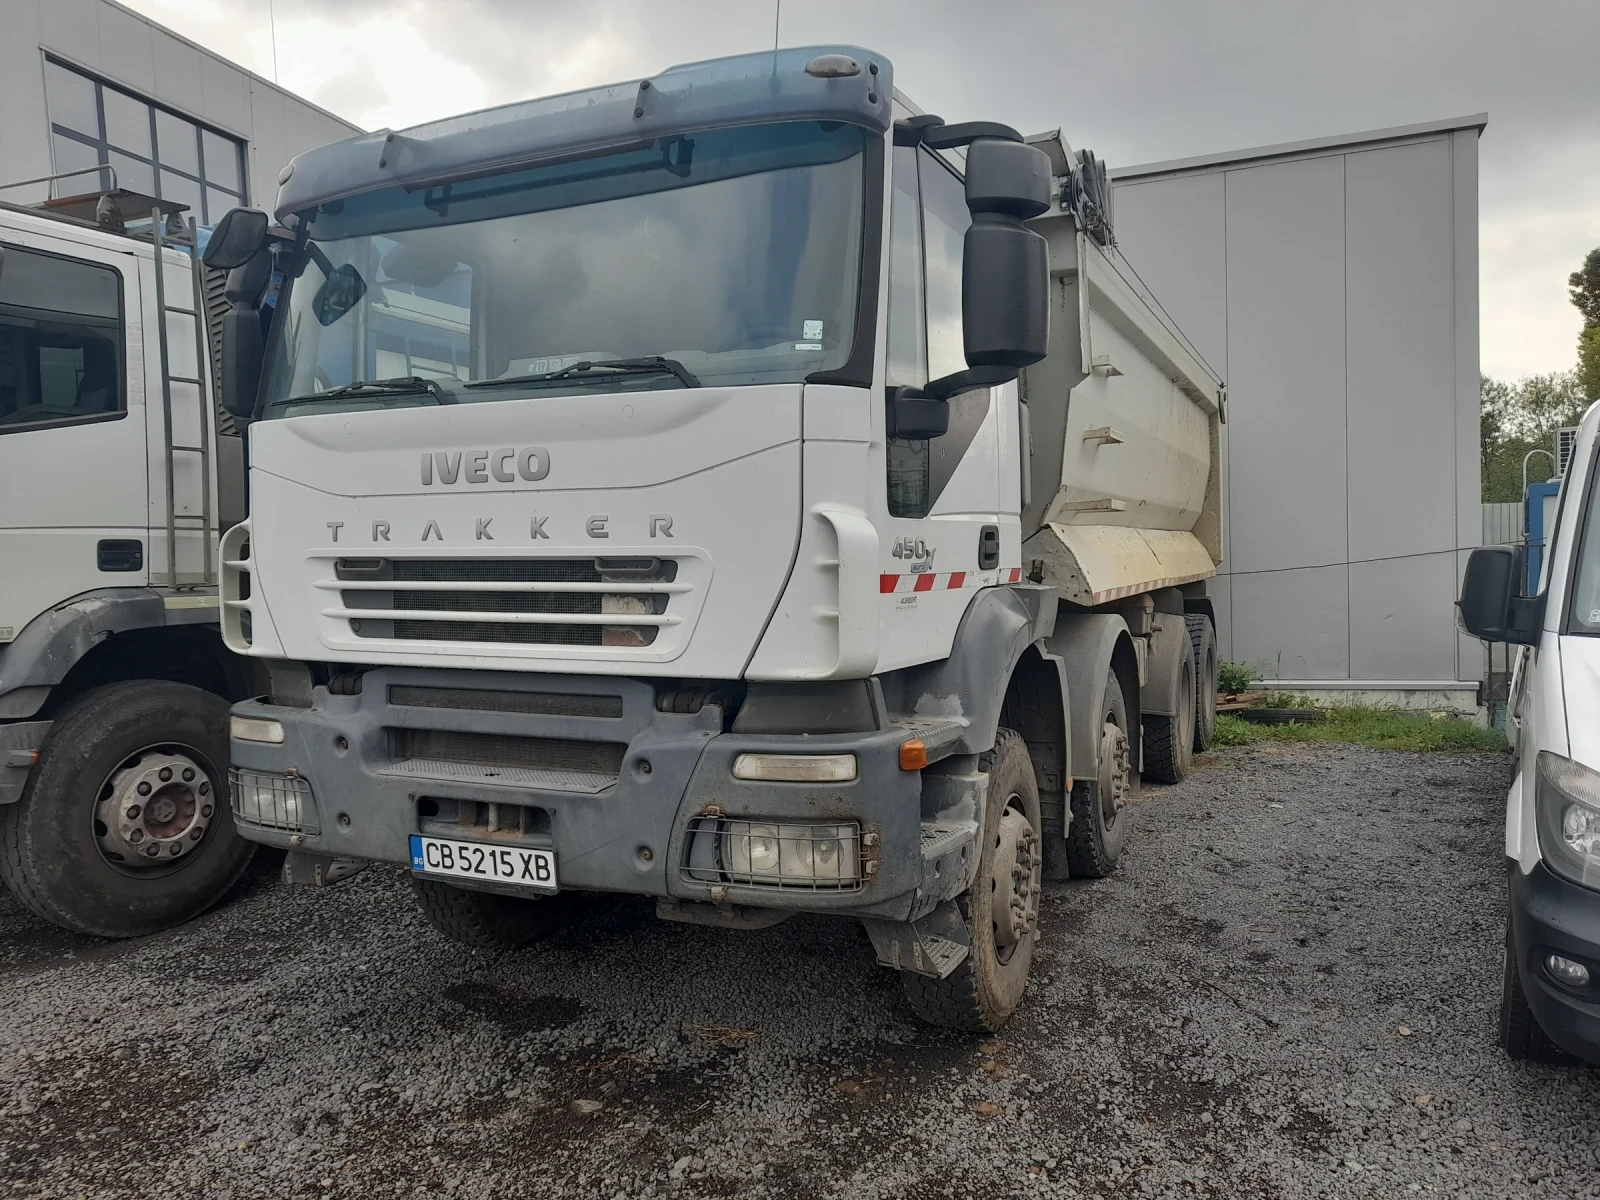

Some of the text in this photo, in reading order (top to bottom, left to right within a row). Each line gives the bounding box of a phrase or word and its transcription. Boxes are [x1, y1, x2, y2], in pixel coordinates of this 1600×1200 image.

[420, 447, 550, 485] IVECO
[326, 513, 673, 542] TRAKKER
[892, 536, 926, 560] 450
[413, 857, 424, 865] BG
